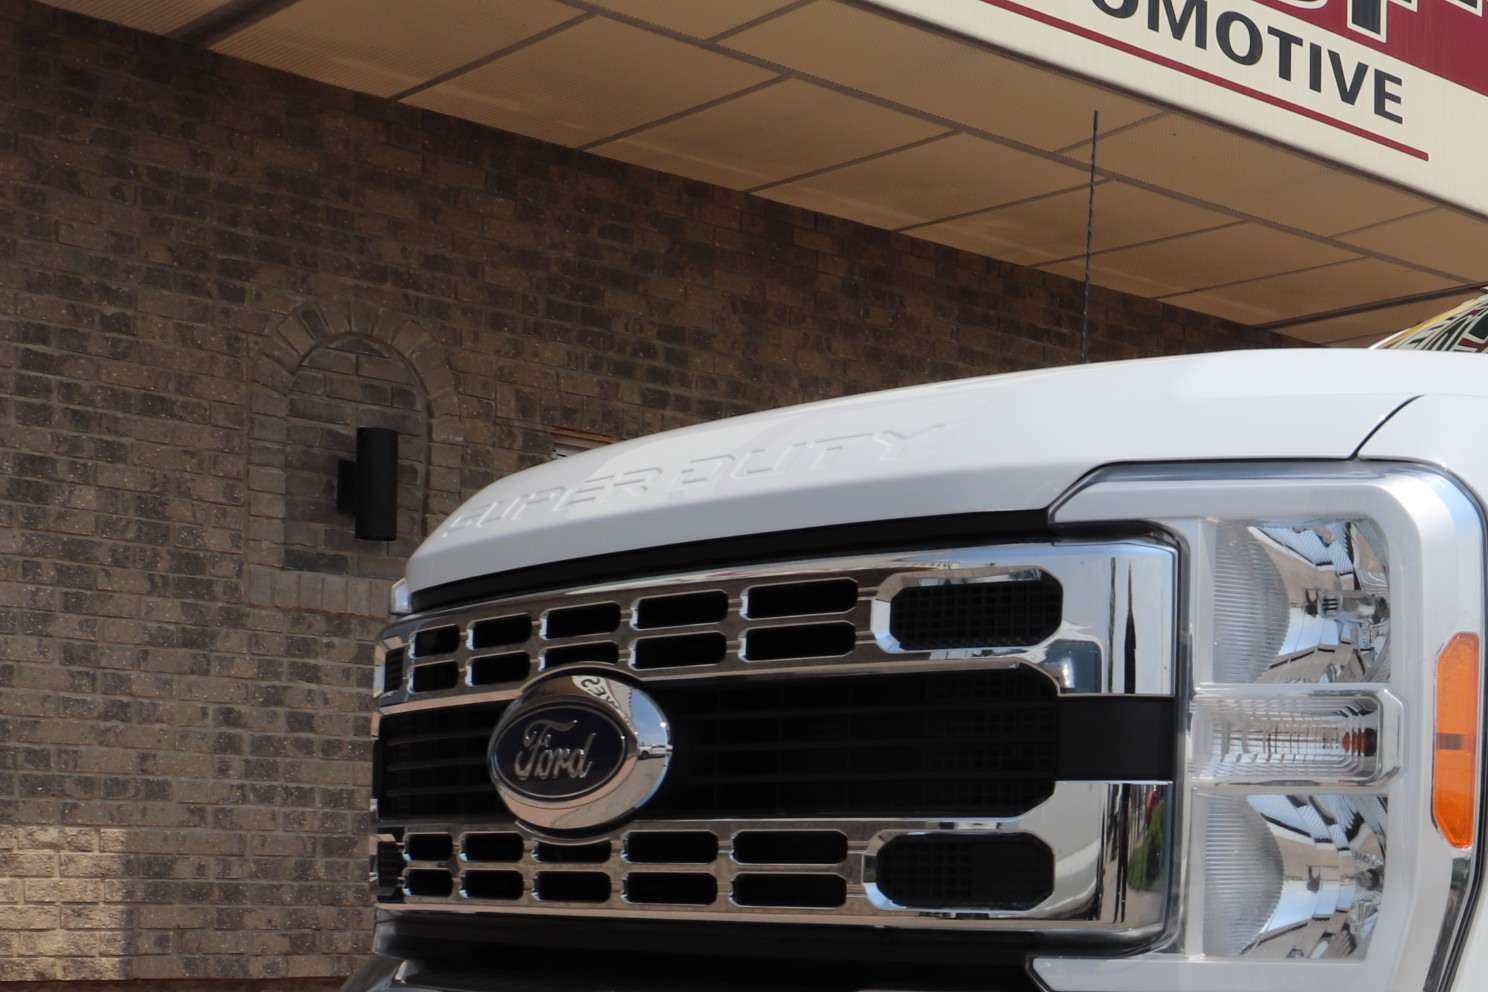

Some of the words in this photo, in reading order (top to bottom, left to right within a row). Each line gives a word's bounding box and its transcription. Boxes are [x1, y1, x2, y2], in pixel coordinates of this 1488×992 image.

[441, 466, 662, 538] SUPER
[666, 423, 947, 493] DUTY
[513, 719, 597, 781] Ford
